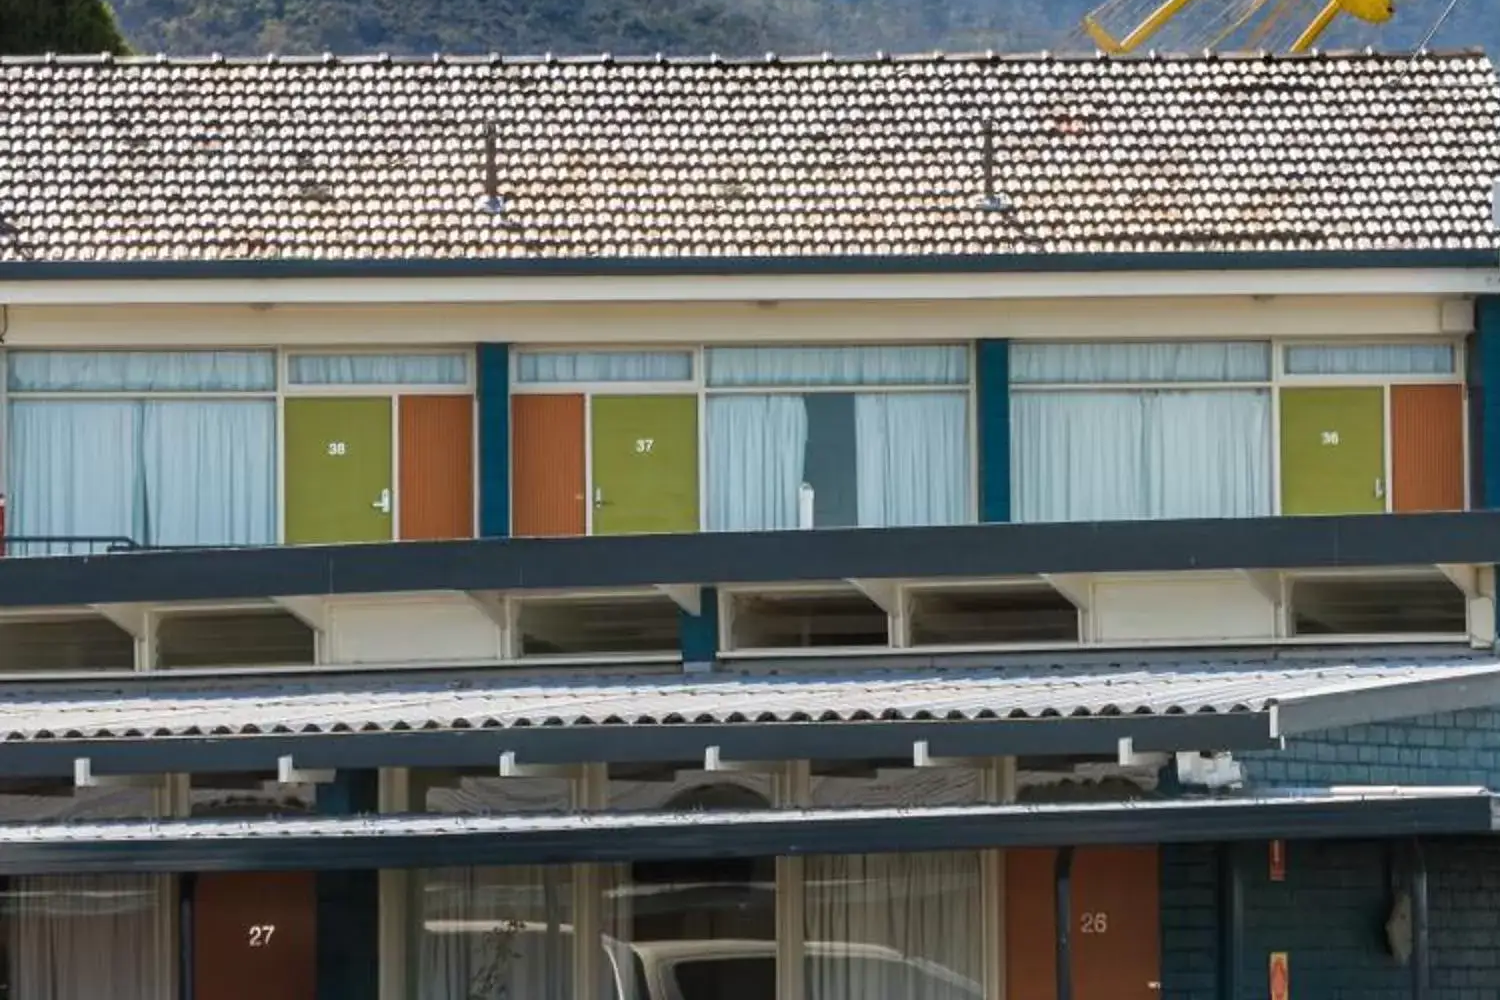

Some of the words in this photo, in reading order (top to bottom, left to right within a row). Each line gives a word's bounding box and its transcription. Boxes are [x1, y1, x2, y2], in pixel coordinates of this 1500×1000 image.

[635, 438, 654, 453] 37
[1080, 911, 1108, 933] 26
[249, 924, 275, 947] 27
